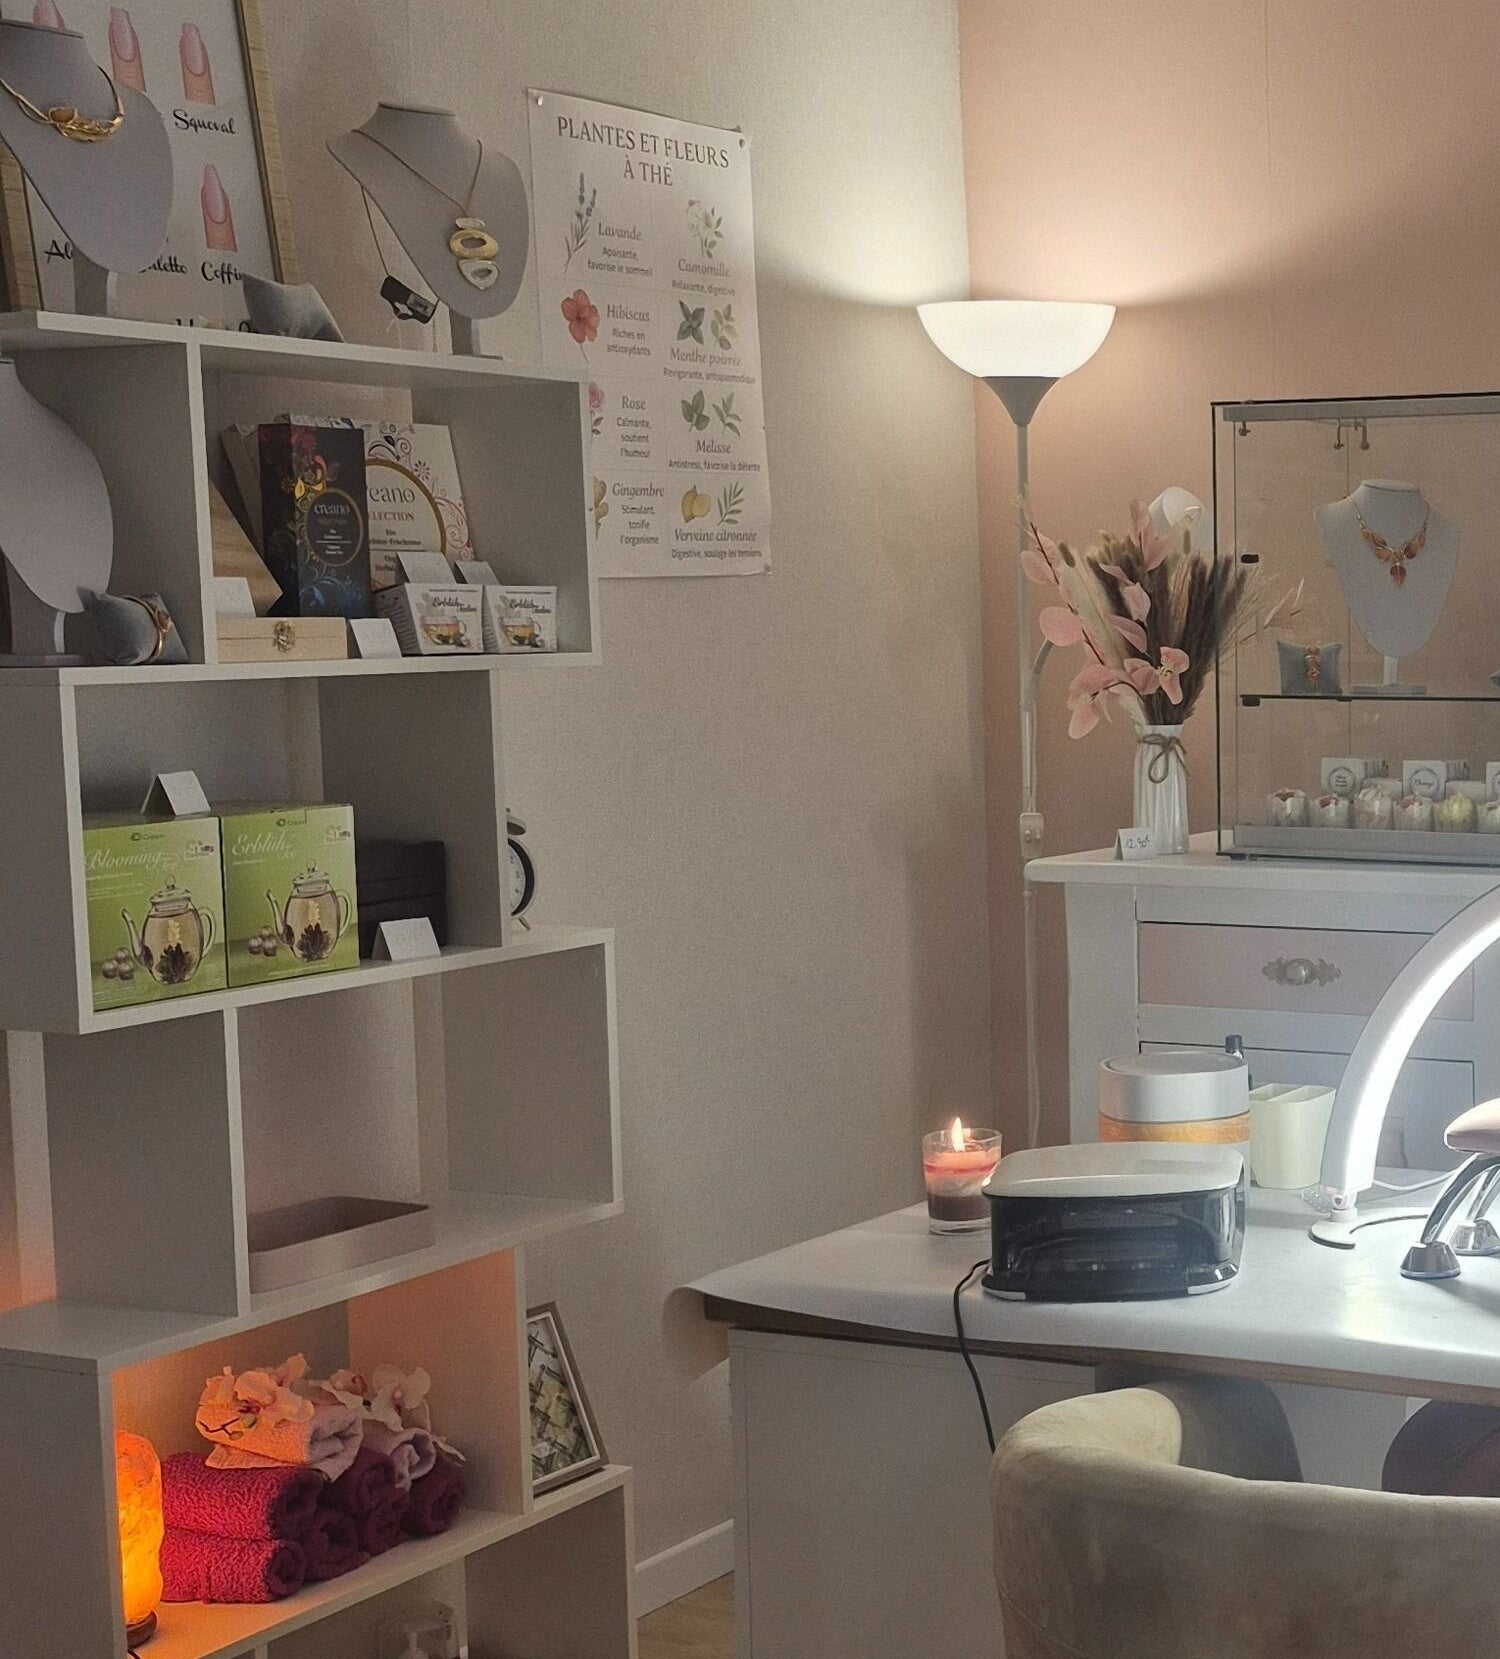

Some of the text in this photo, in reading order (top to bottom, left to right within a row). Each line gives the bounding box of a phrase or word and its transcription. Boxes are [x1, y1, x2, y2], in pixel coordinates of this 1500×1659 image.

[557, 116, 729, 168] PLANTES ET FLEURS
[623, 155, 673, 186] À THÉ
[598, 222, 642, 241] Lavande
[678, 258, 731, 277] Camomille
[607, 304, 650, 321] Hibiscus
[670, 347, 707, 364] Menthe
[622, 396, 646, 410] Rose
[612, 482, 665, 500] Gingembre
[674, 528, 714, 542] Verveine
